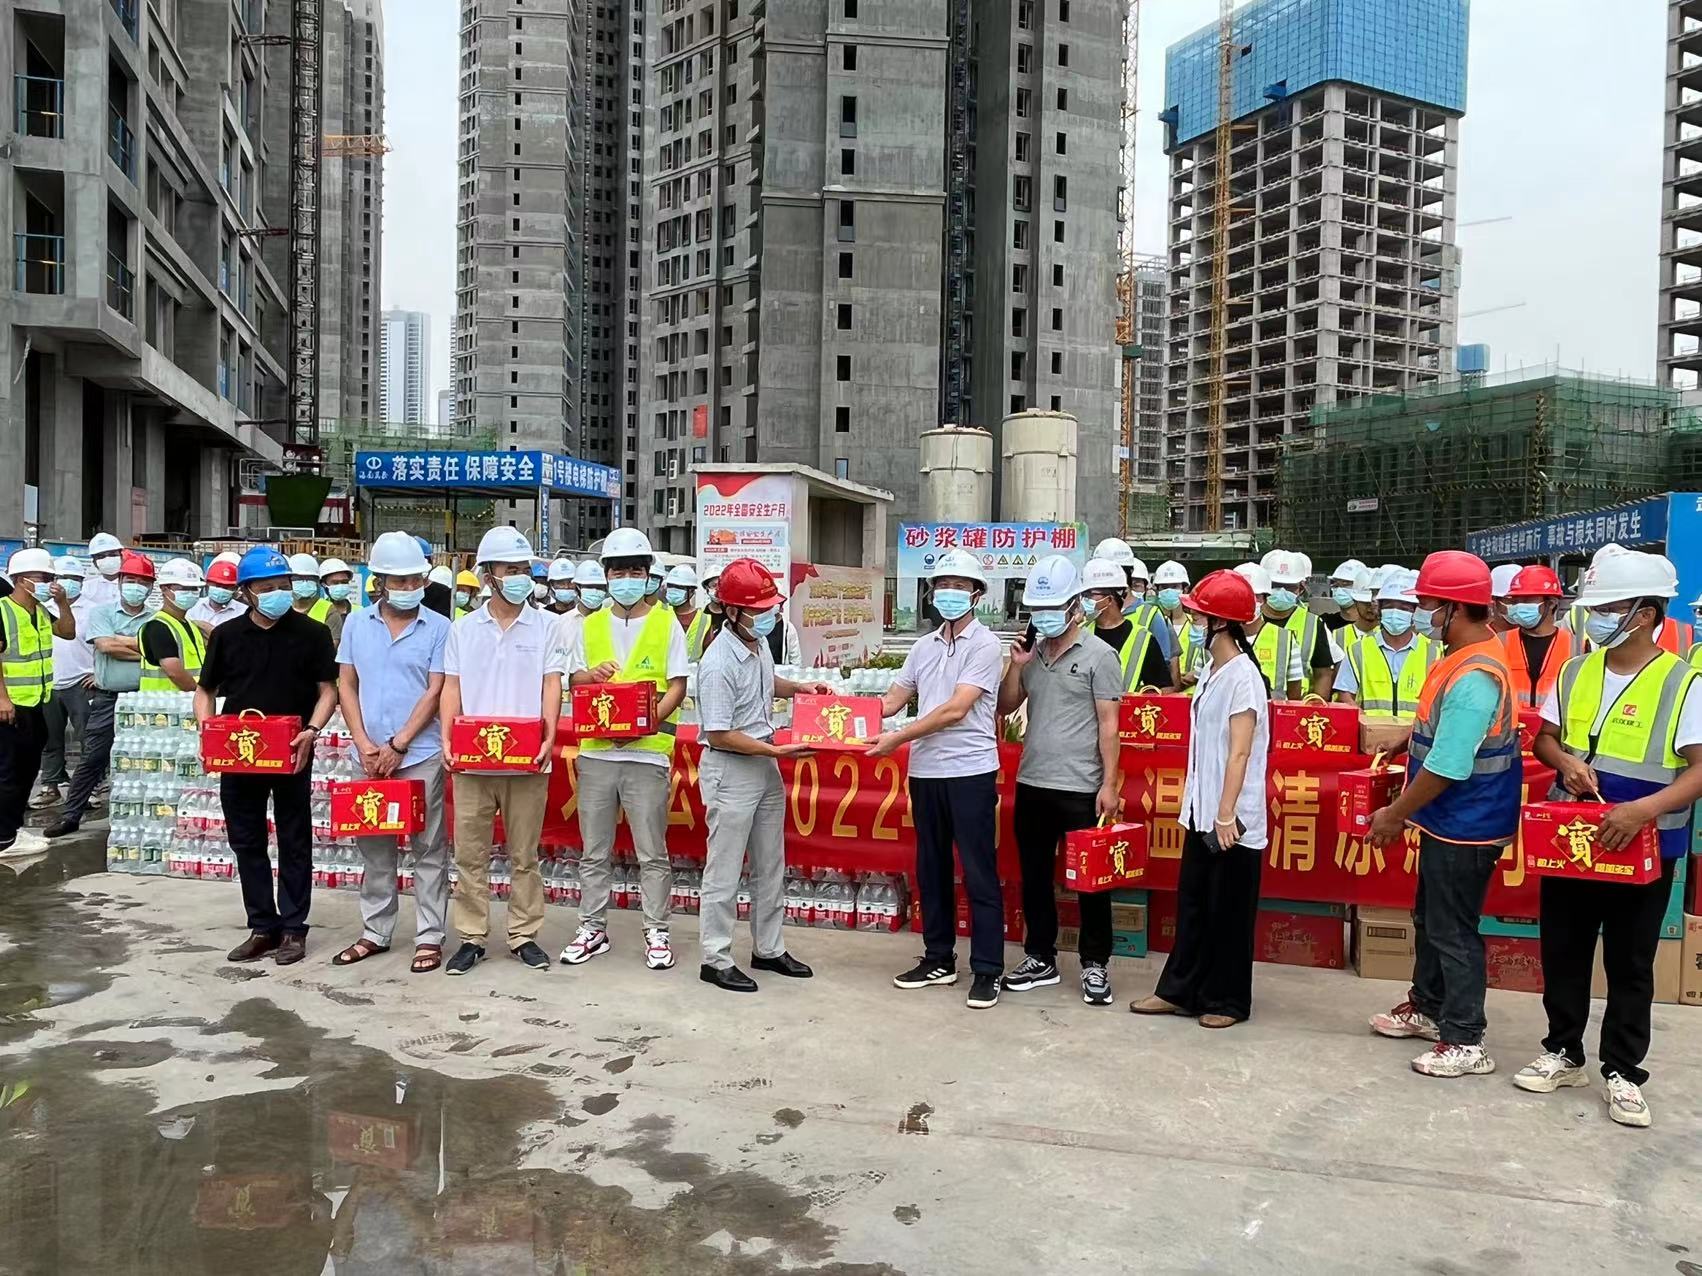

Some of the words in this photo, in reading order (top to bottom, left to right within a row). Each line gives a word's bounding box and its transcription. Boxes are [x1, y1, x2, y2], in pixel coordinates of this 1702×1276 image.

[392, 455, 460, 481] 落实责任
[465, 455, 534, 481] 保障安全
[703, 503, 786, 517] 2022年全国安全生产月
[905, 527, 1078, 549] 砂浆罐防护棚
[1547, 509, 1642, 549] 事故与损失同时发生
